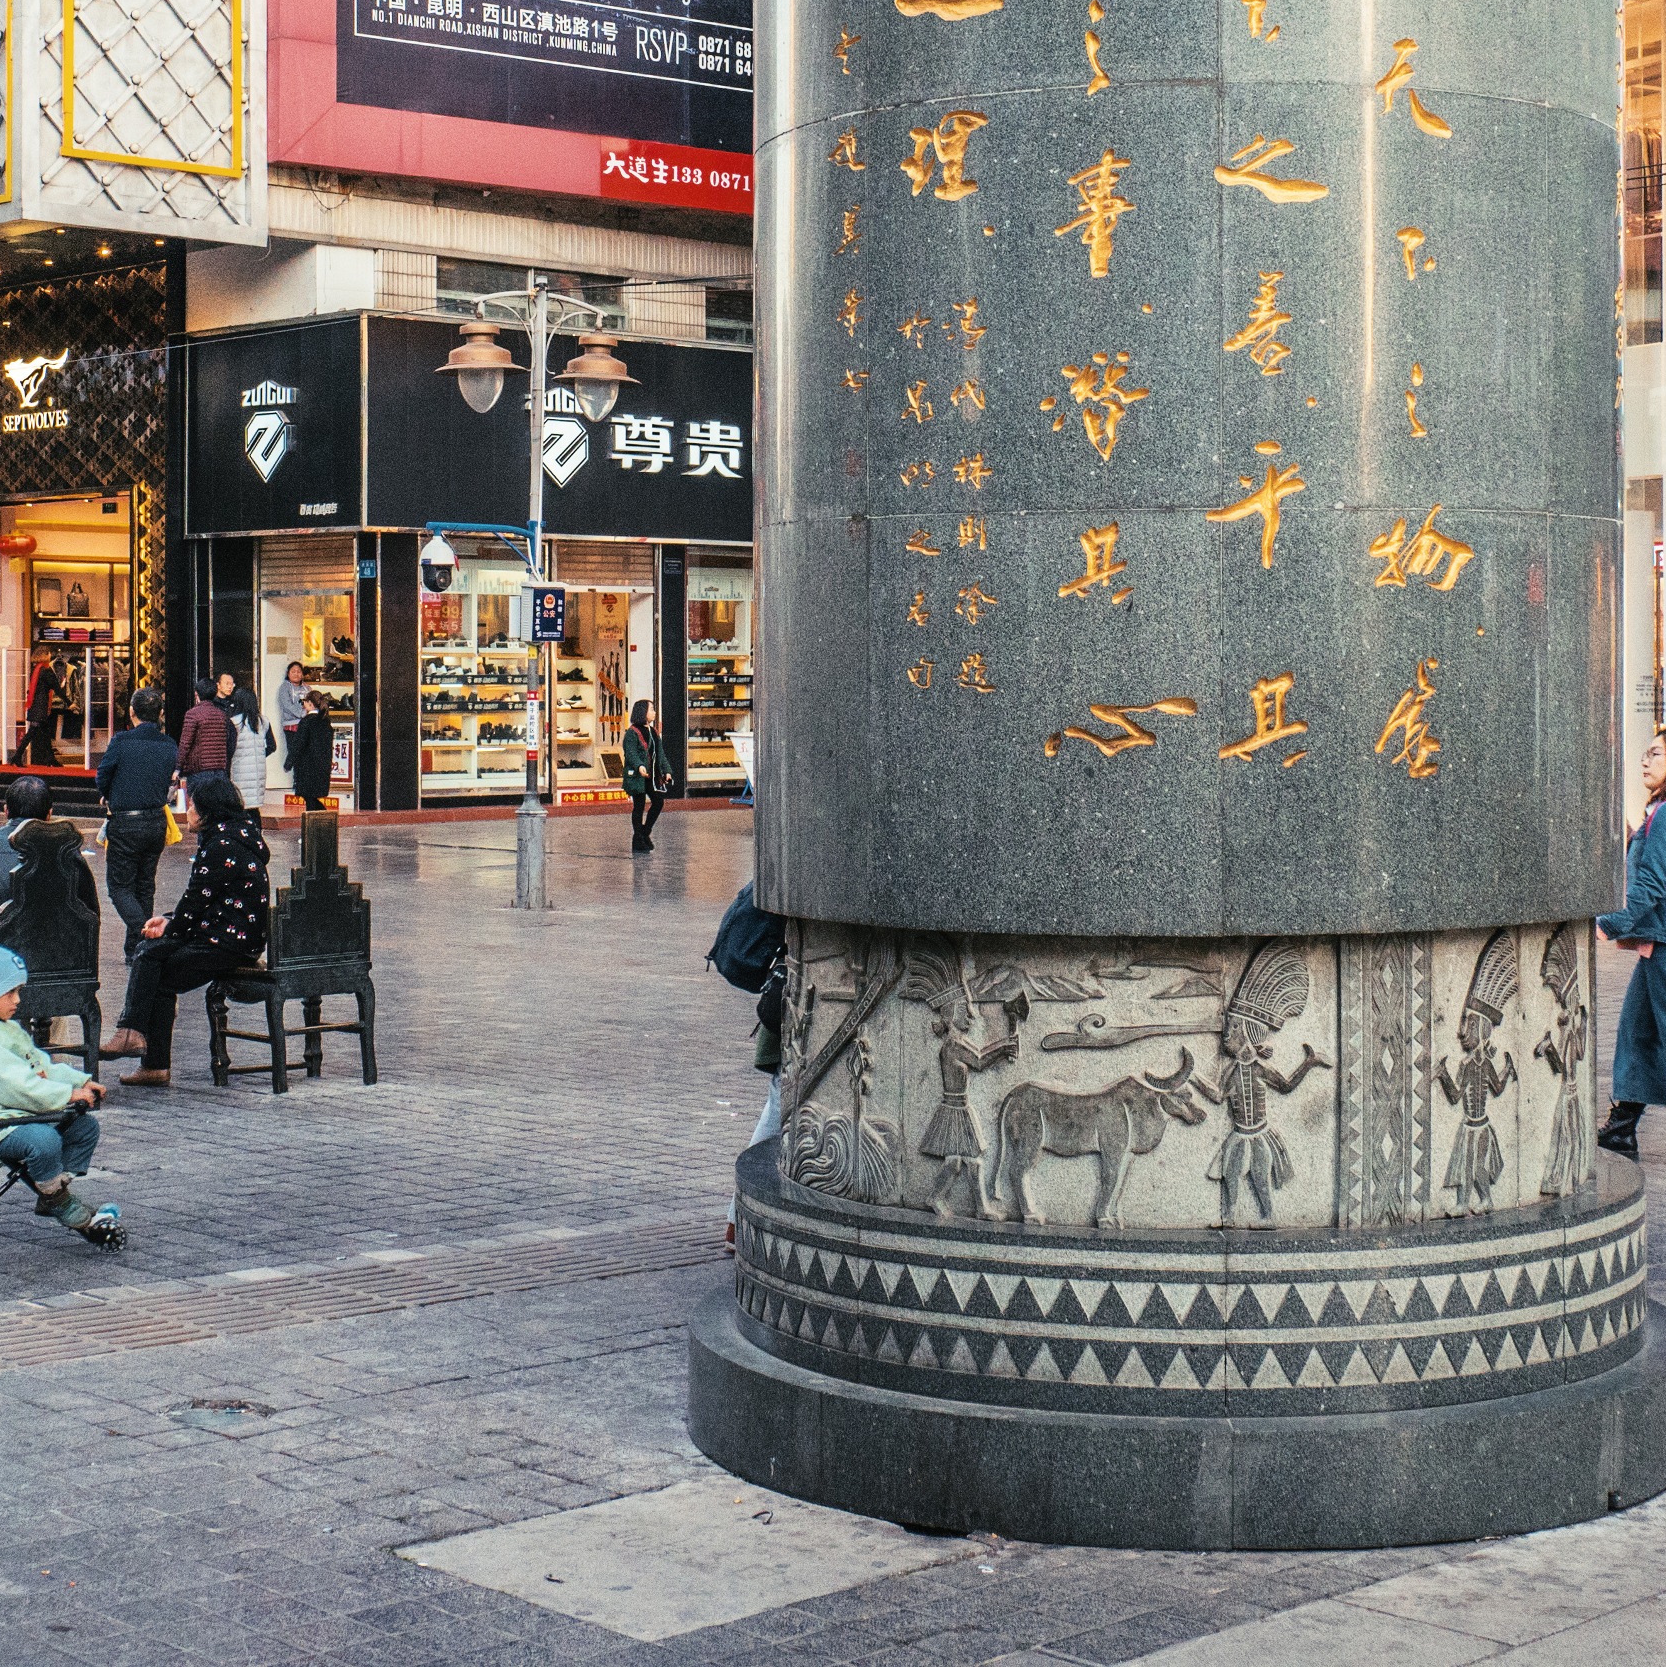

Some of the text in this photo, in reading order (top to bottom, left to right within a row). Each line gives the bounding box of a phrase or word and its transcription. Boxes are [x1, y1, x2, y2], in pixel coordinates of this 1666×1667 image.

[372, 9, 393, 25] NO.1
[398, 12, 435, 30] DIANCHI
[503, 27, 543, 46] DISTRICT
[636, 26, 689, 65] RSVP
[699, 35, 730, 56] 0871
[699, 52, 730, 74] 0871
[710, 172, 752, 192] 0871
[3, 410, 69, 432] SEPTWOLVES
[610, 413, 744, 479] 尊贵
[542, 610, 556, 618] 公安
